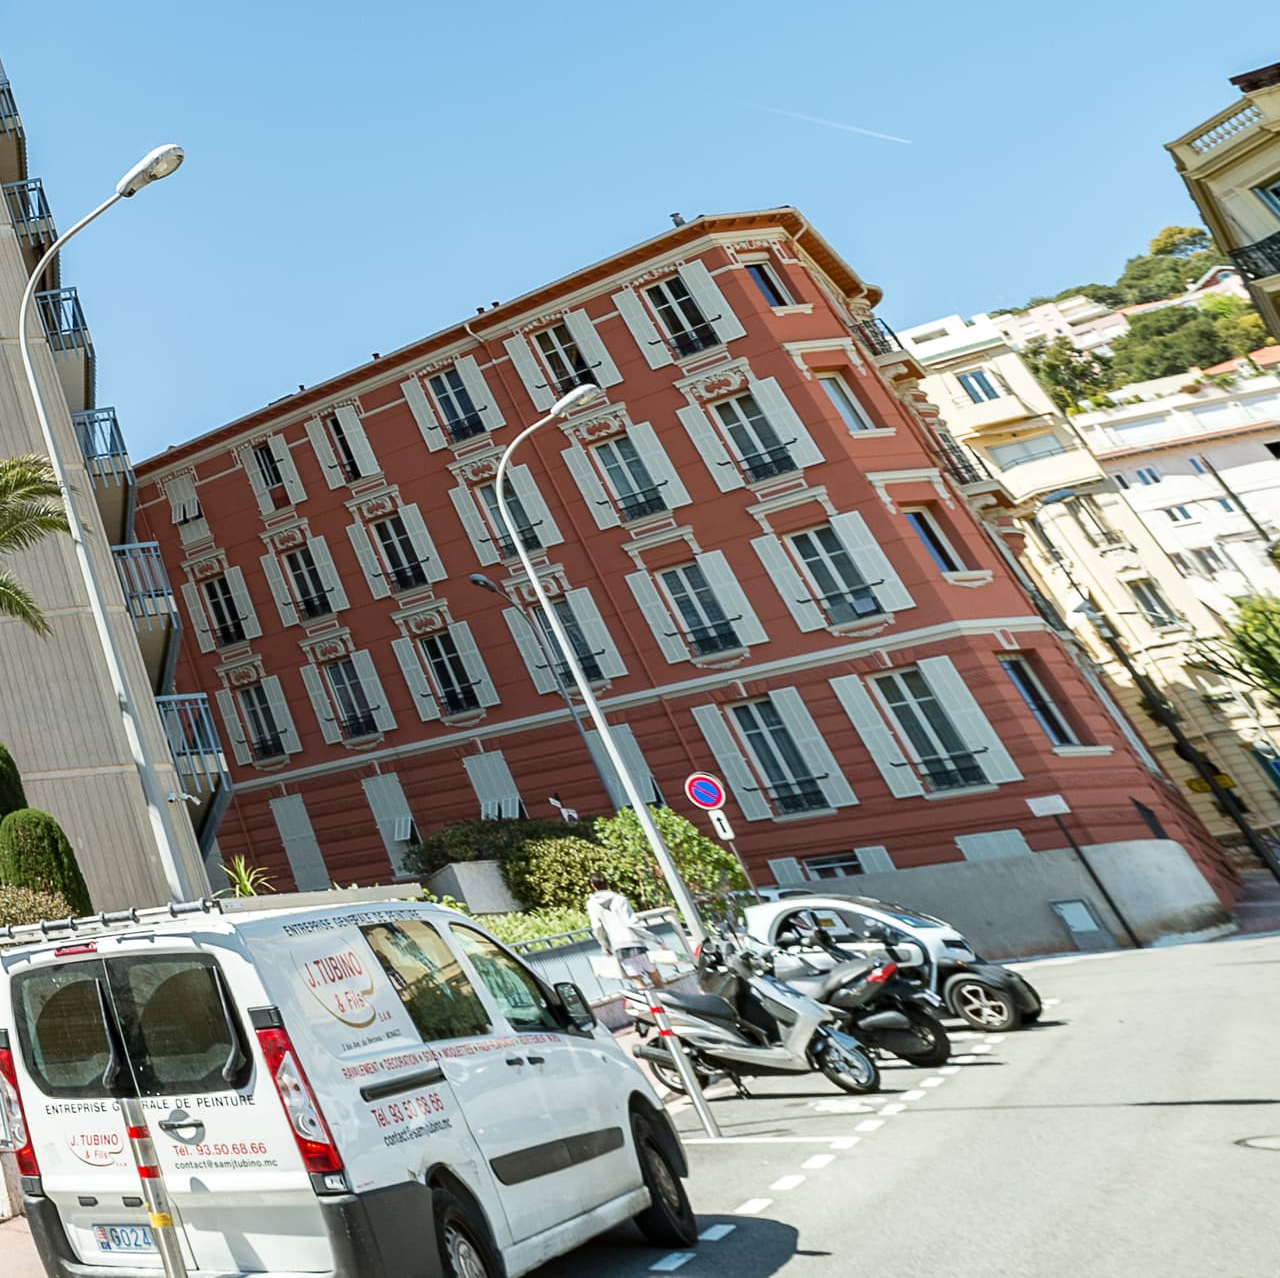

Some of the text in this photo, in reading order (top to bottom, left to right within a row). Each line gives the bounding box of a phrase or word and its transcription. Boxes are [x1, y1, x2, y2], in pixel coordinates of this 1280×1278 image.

[282, 918, 334, 937] ENTREPRISE
[44, 1101, 108, 1115] ENTREPRISE
[175, 1097, 192, 1109] DE
[196, 1094, 256, 1108] PEINTURE
[195, 1141, 268, 1156] 93.50.68.66
